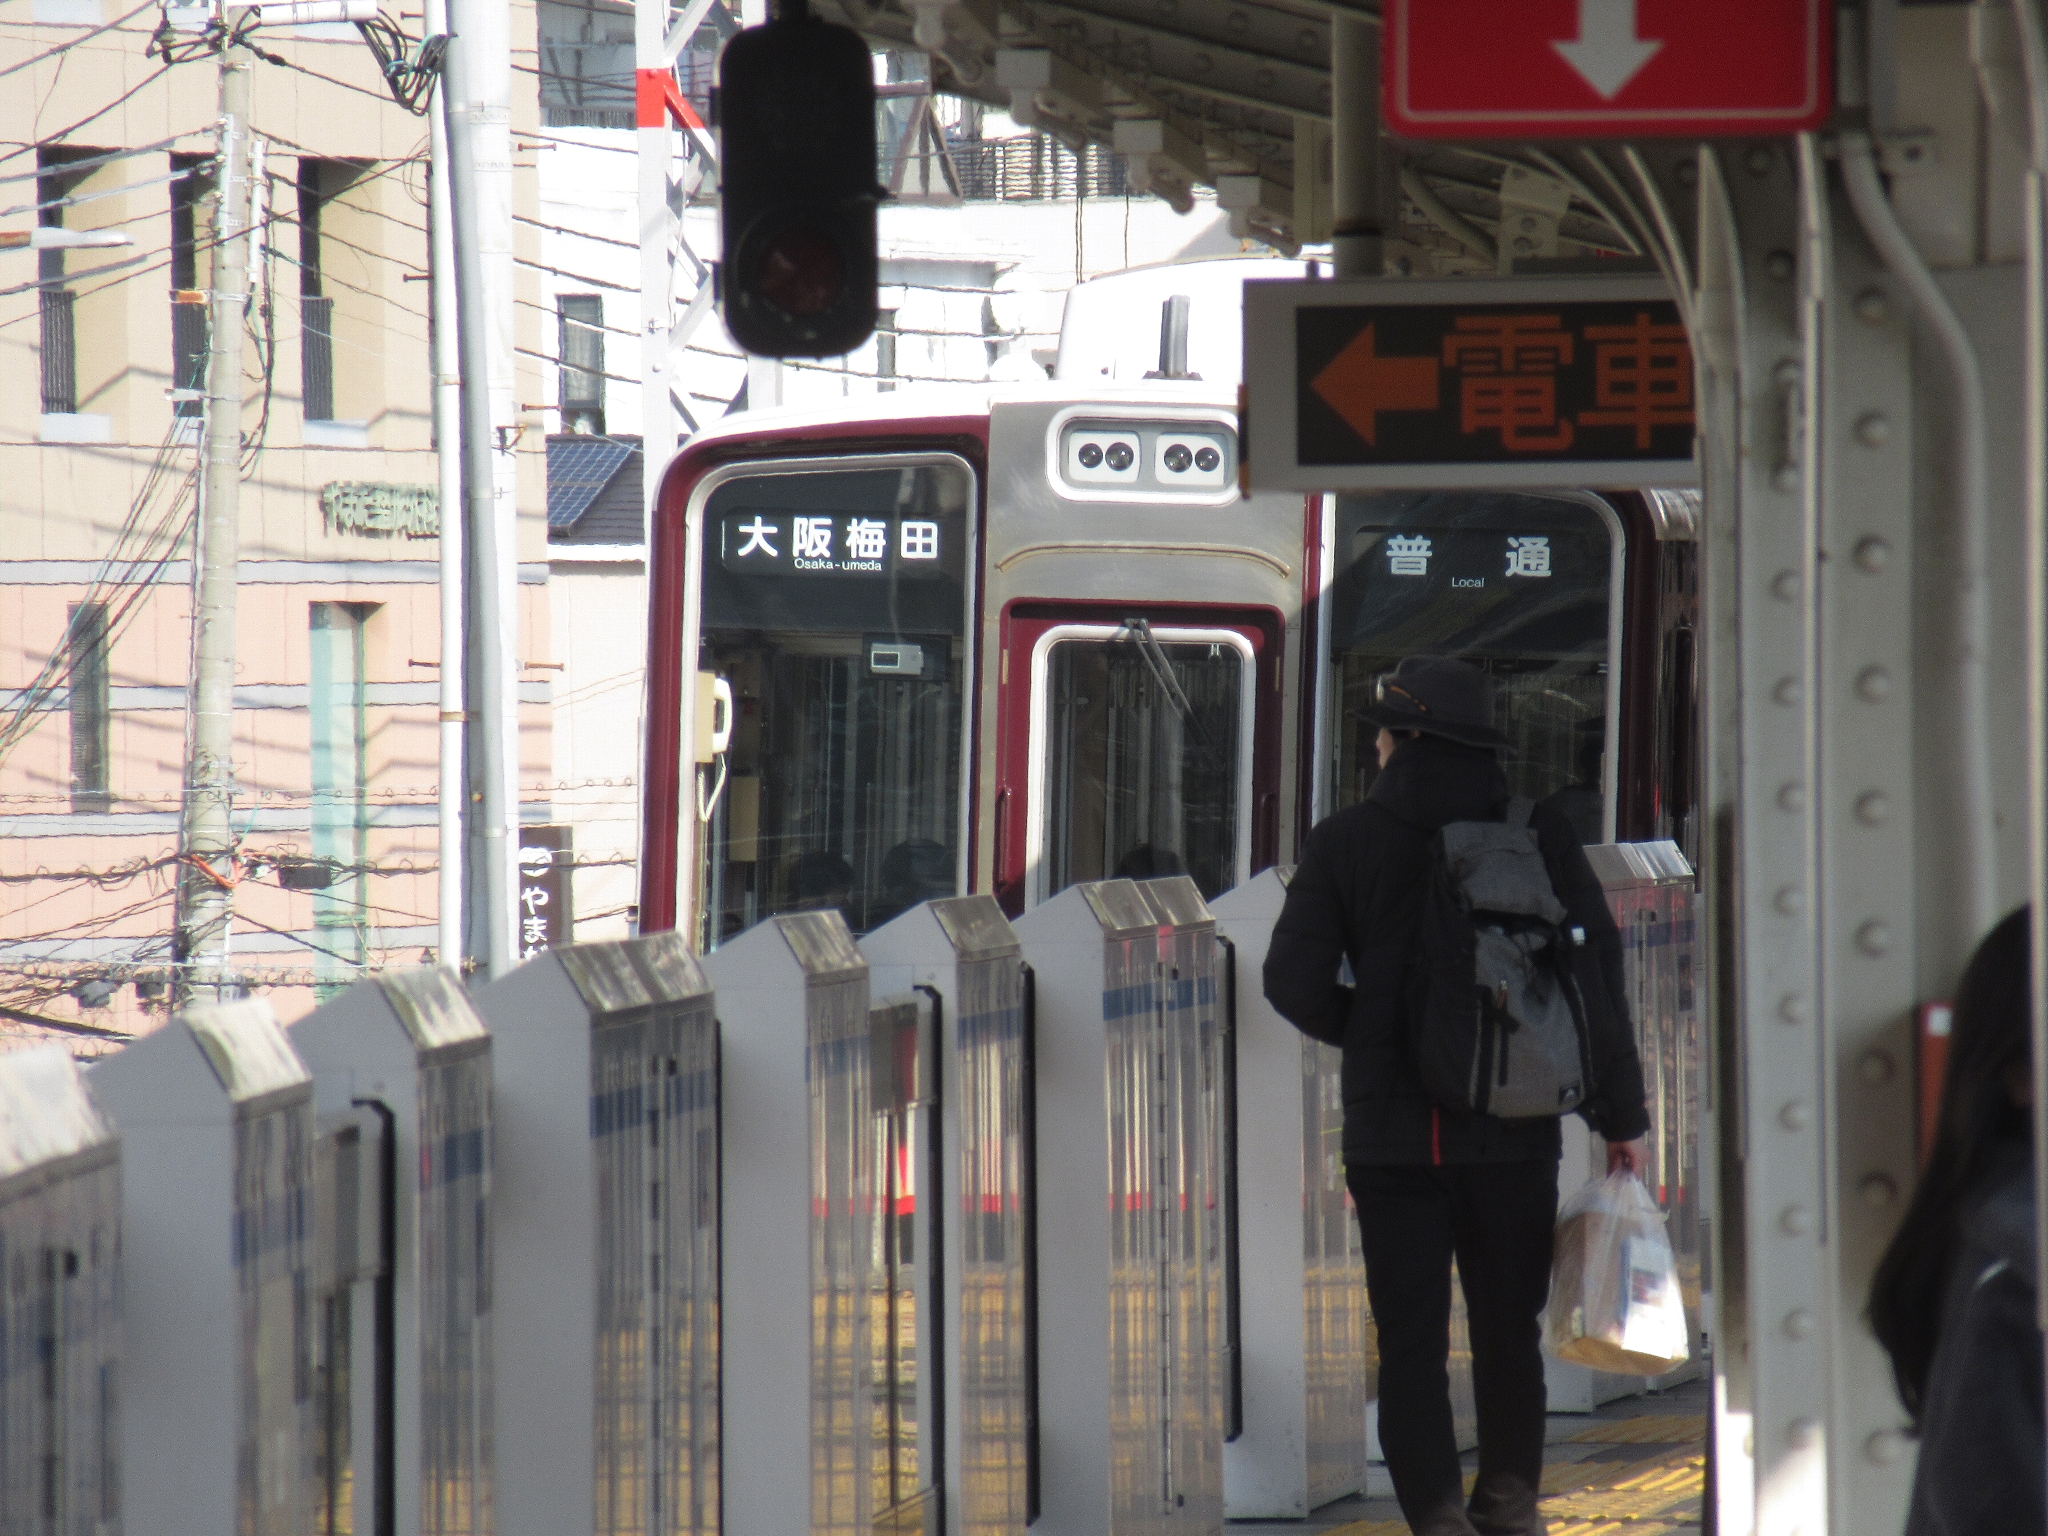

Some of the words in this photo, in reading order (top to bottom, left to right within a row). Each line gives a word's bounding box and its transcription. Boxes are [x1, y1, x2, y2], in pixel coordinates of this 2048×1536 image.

[1442, 312, 1697, 452] 電車
[737, 515, 939, 559] 大阪梅田
[1386, 534, 1552, 577] 普通
[794, 557, 882, 571] Osaka-umeda
[1451, 577, 1486, 588] Local
